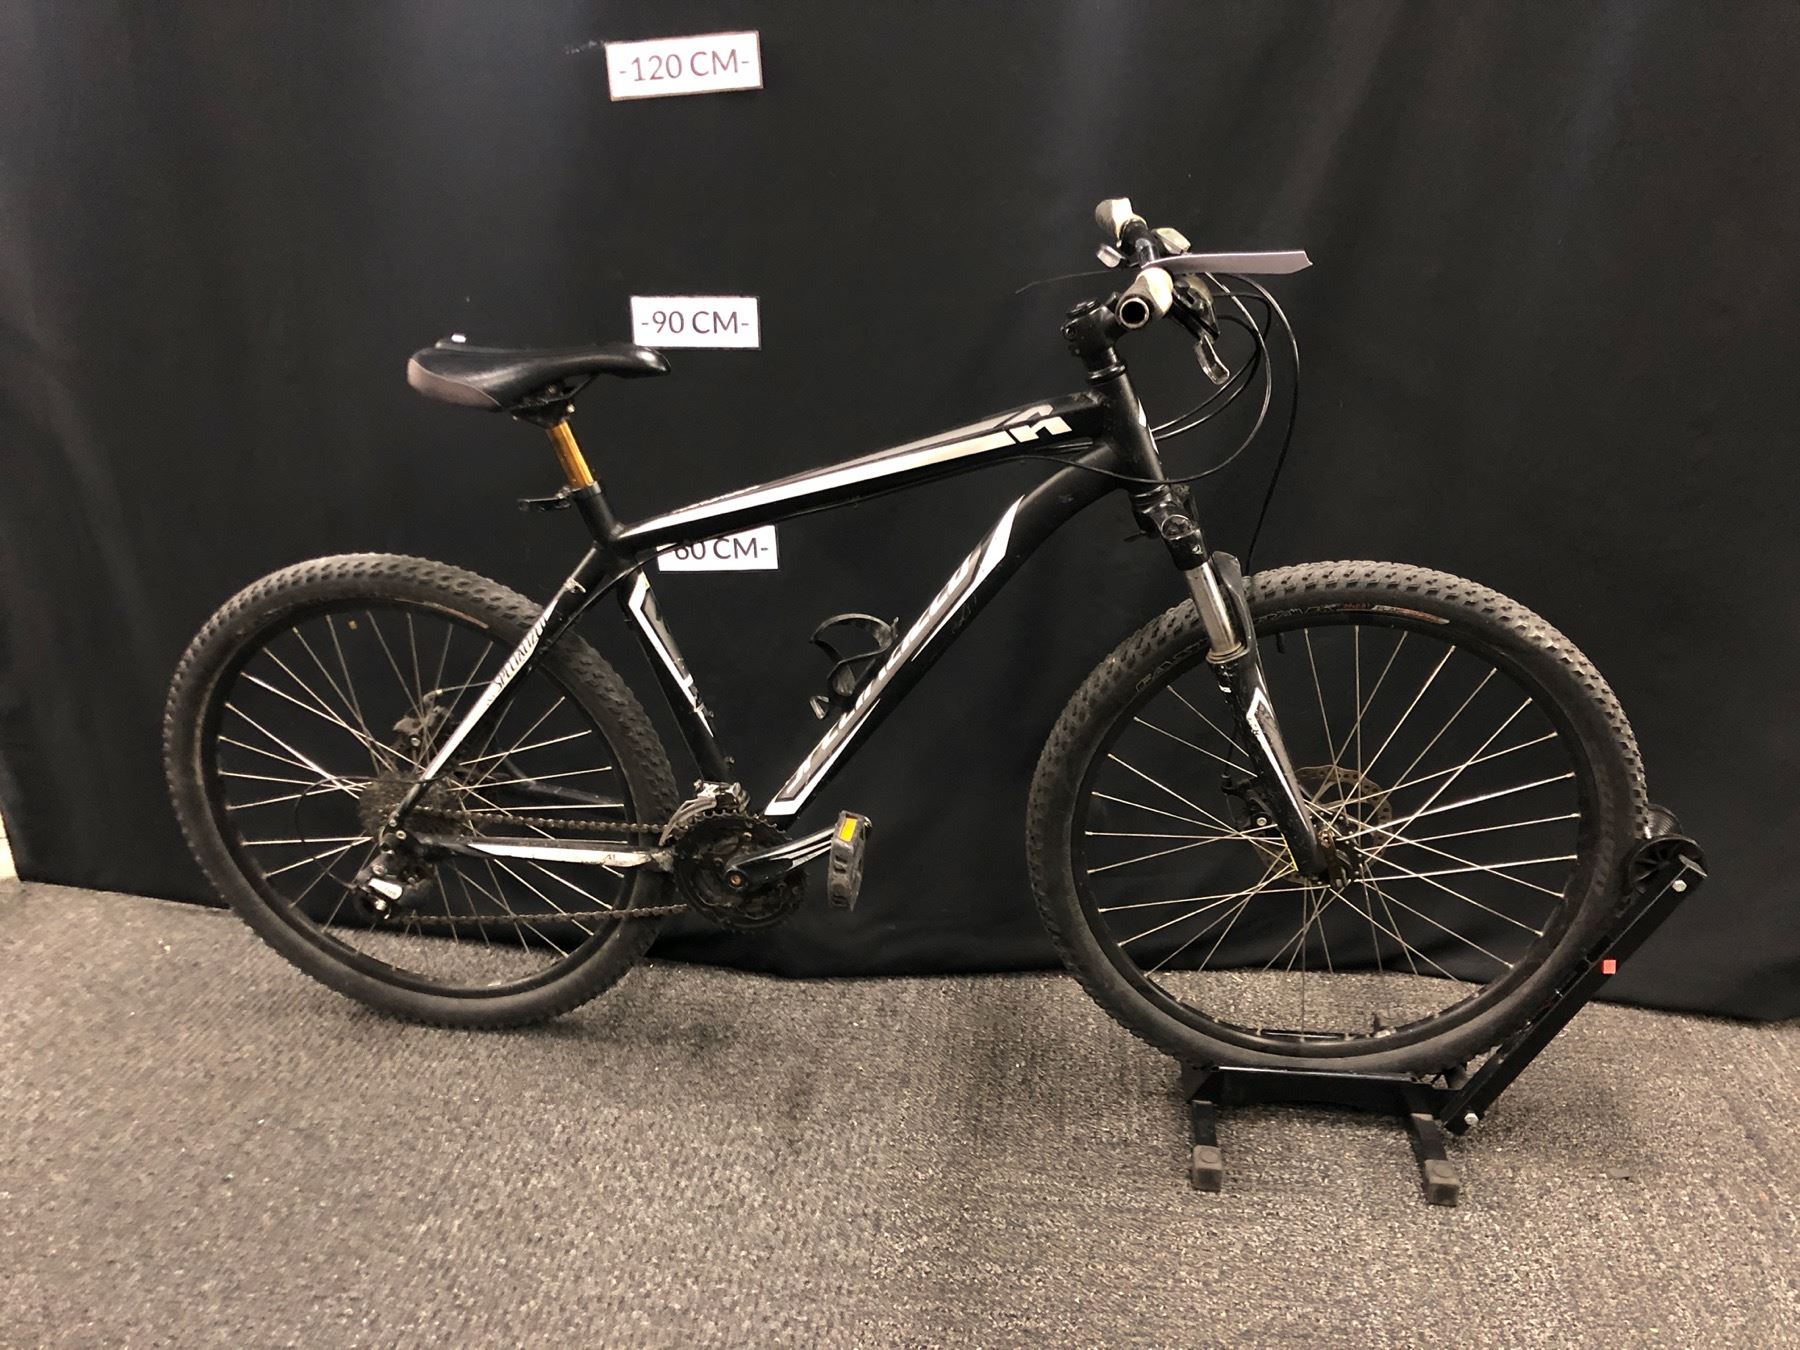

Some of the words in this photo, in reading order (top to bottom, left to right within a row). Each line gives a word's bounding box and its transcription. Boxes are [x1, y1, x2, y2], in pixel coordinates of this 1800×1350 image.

[619, 54, 683, 82] -120
[690, 49, 750, 77] CM-
[641, 310, 684, 334] -90
[692, 311, 749, 334] CM-
[713, 537, 769, 559] CM-
